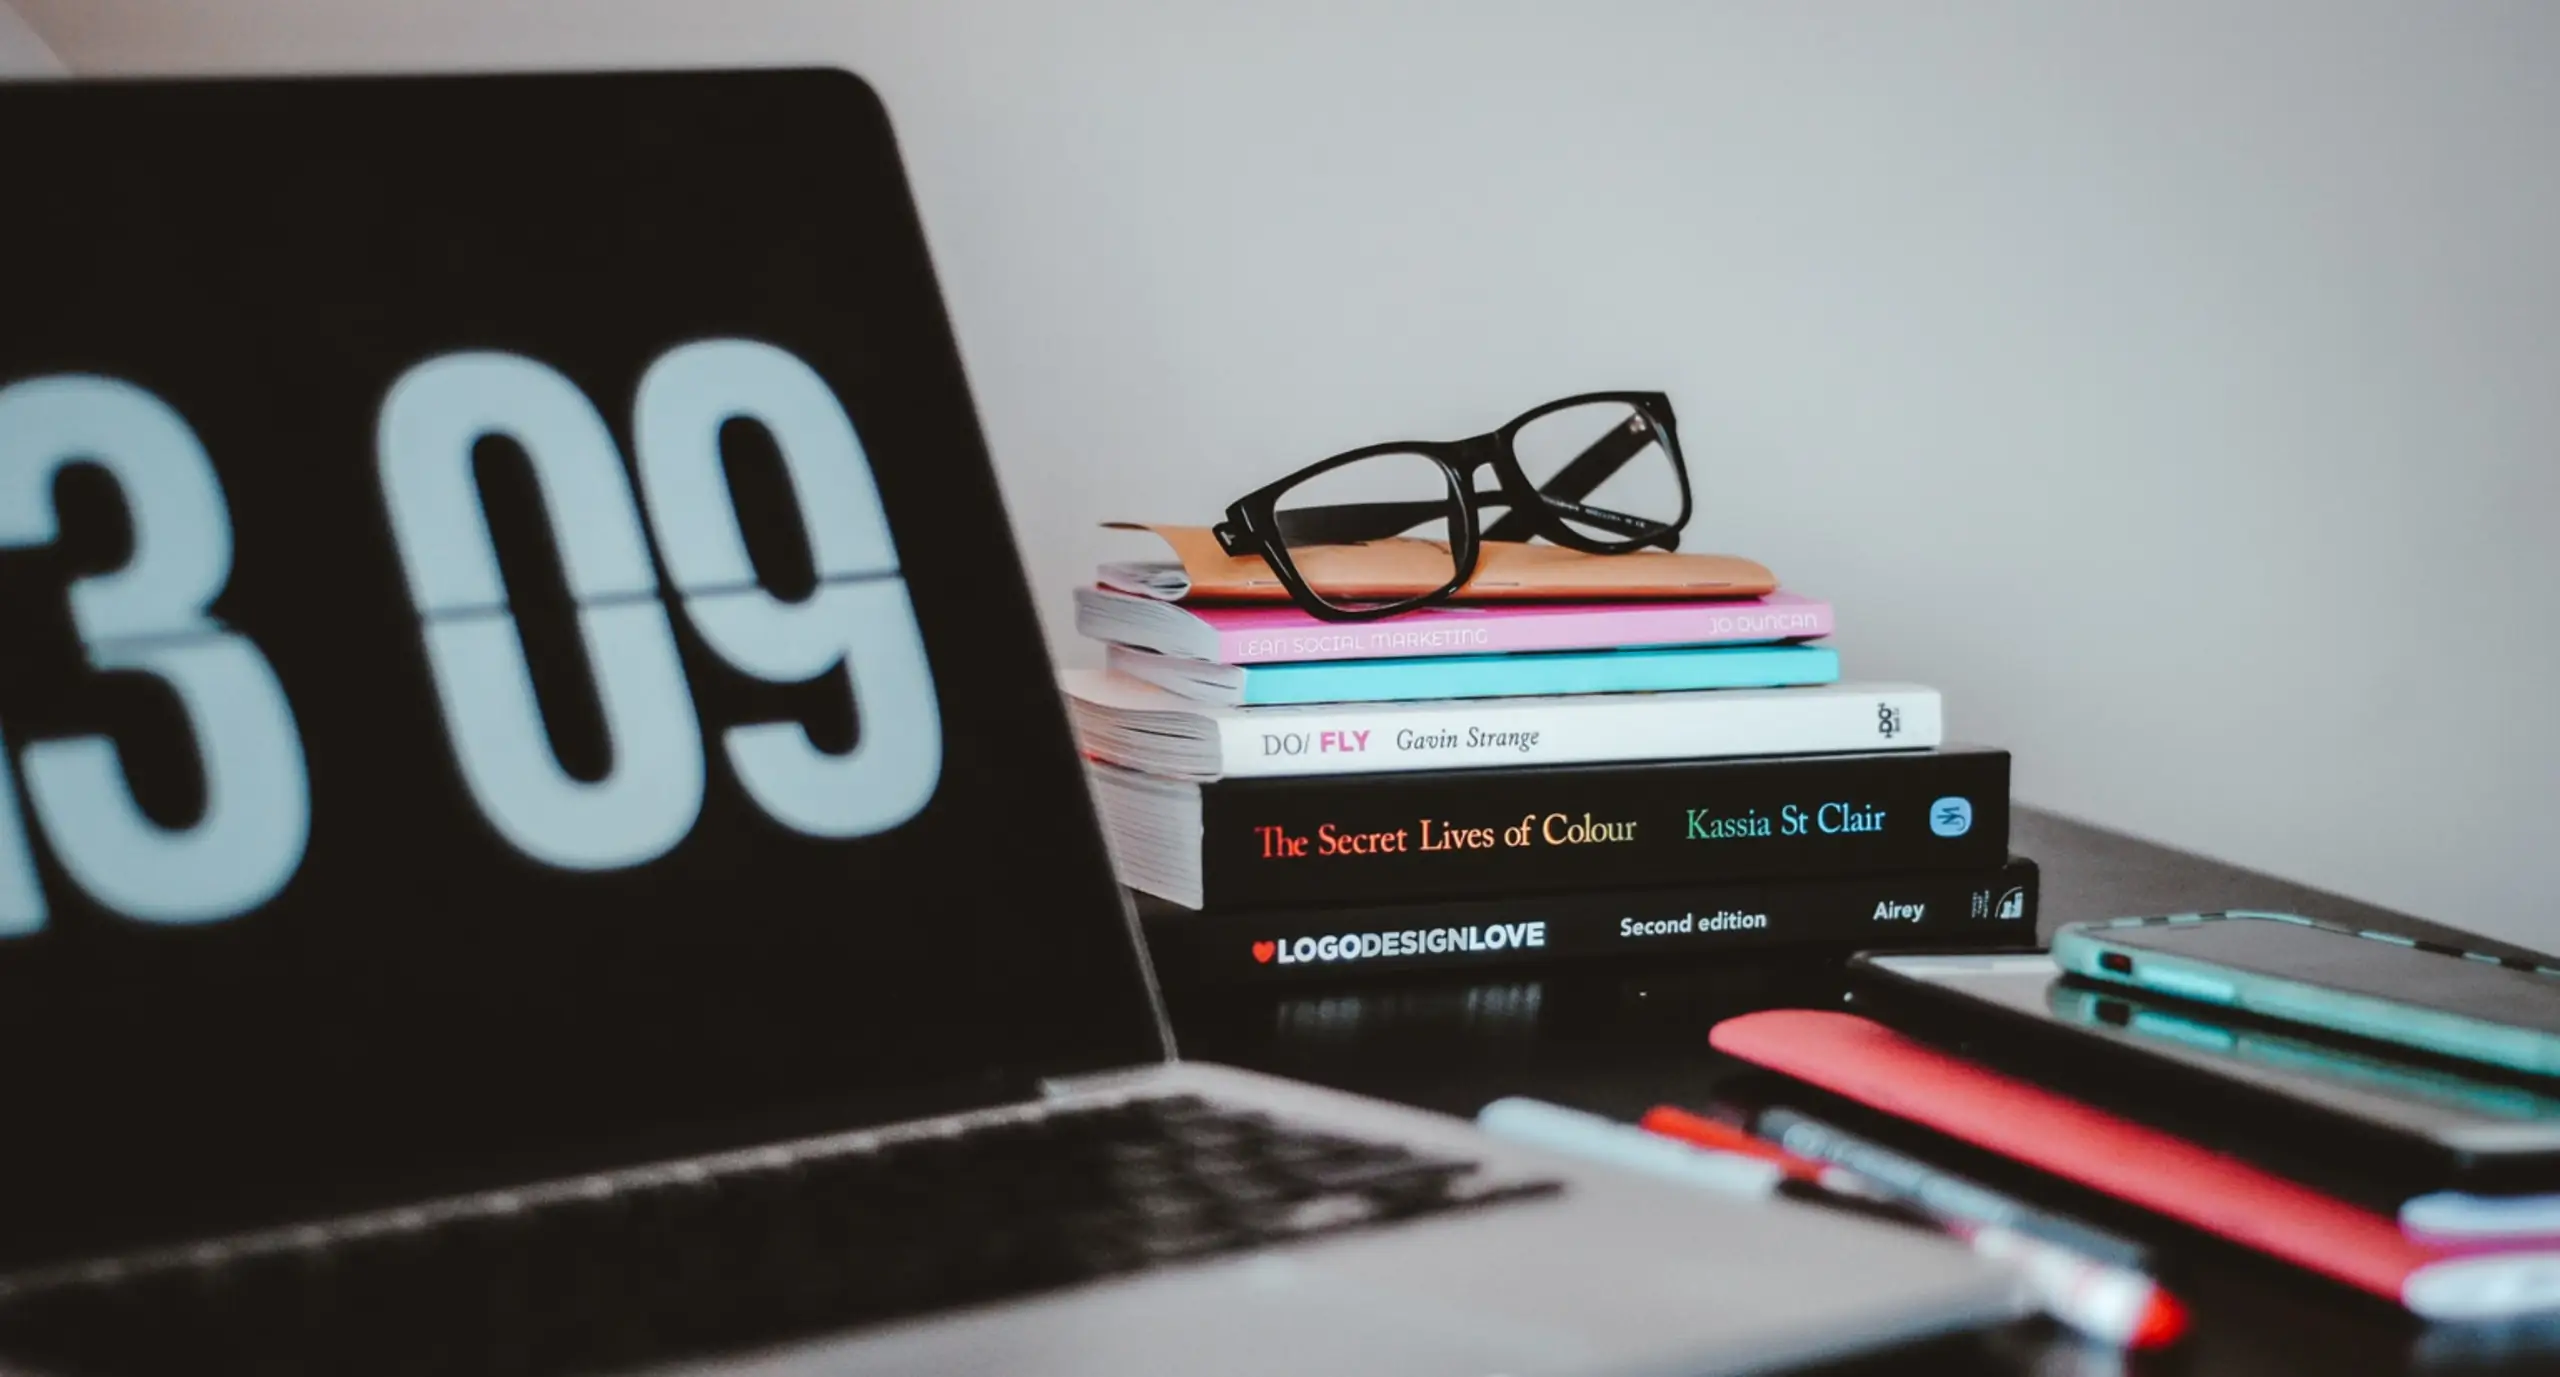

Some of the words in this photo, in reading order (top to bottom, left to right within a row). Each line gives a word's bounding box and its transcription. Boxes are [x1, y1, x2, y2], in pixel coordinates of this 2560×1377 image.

[0, 373, 311, 938] 3
[375, 336, 944, 871] 09
[1708, 616, 1732, 636] JO
[1737, 613, 1818, 633] DUNCAN
[1237, 639, 1287, 658] LEAN
[1293, 635, 1365, 655] SOCIAL
[1371, 628, 1488, 650] MARKETING
[1319, 729, 1371, 753] FLY
[1396, 728, 1459, 751] Gavin
[1466, 727, 1540, 752] Strange
[1254, 825, 1309, 858] The
[1317, 823, 1409, 856] Secret
[1418, 818, 1496, 852] Lives
[1503, 814, 1536, 848] of
[1542, 812, 1638, 846] Colour
[1685, 807, 1772, 840] Kassia
[1780, 804, 1809, 836] St
[1816, 802, 1886, 835] Clair
[1620, 912, 1693, 938] Second
[1697, 910, 1768, 933] edition
[1872, 901, 1925, 923] Airey
[1277, 920, 1547, 965] LOGODESIGNLOVE
